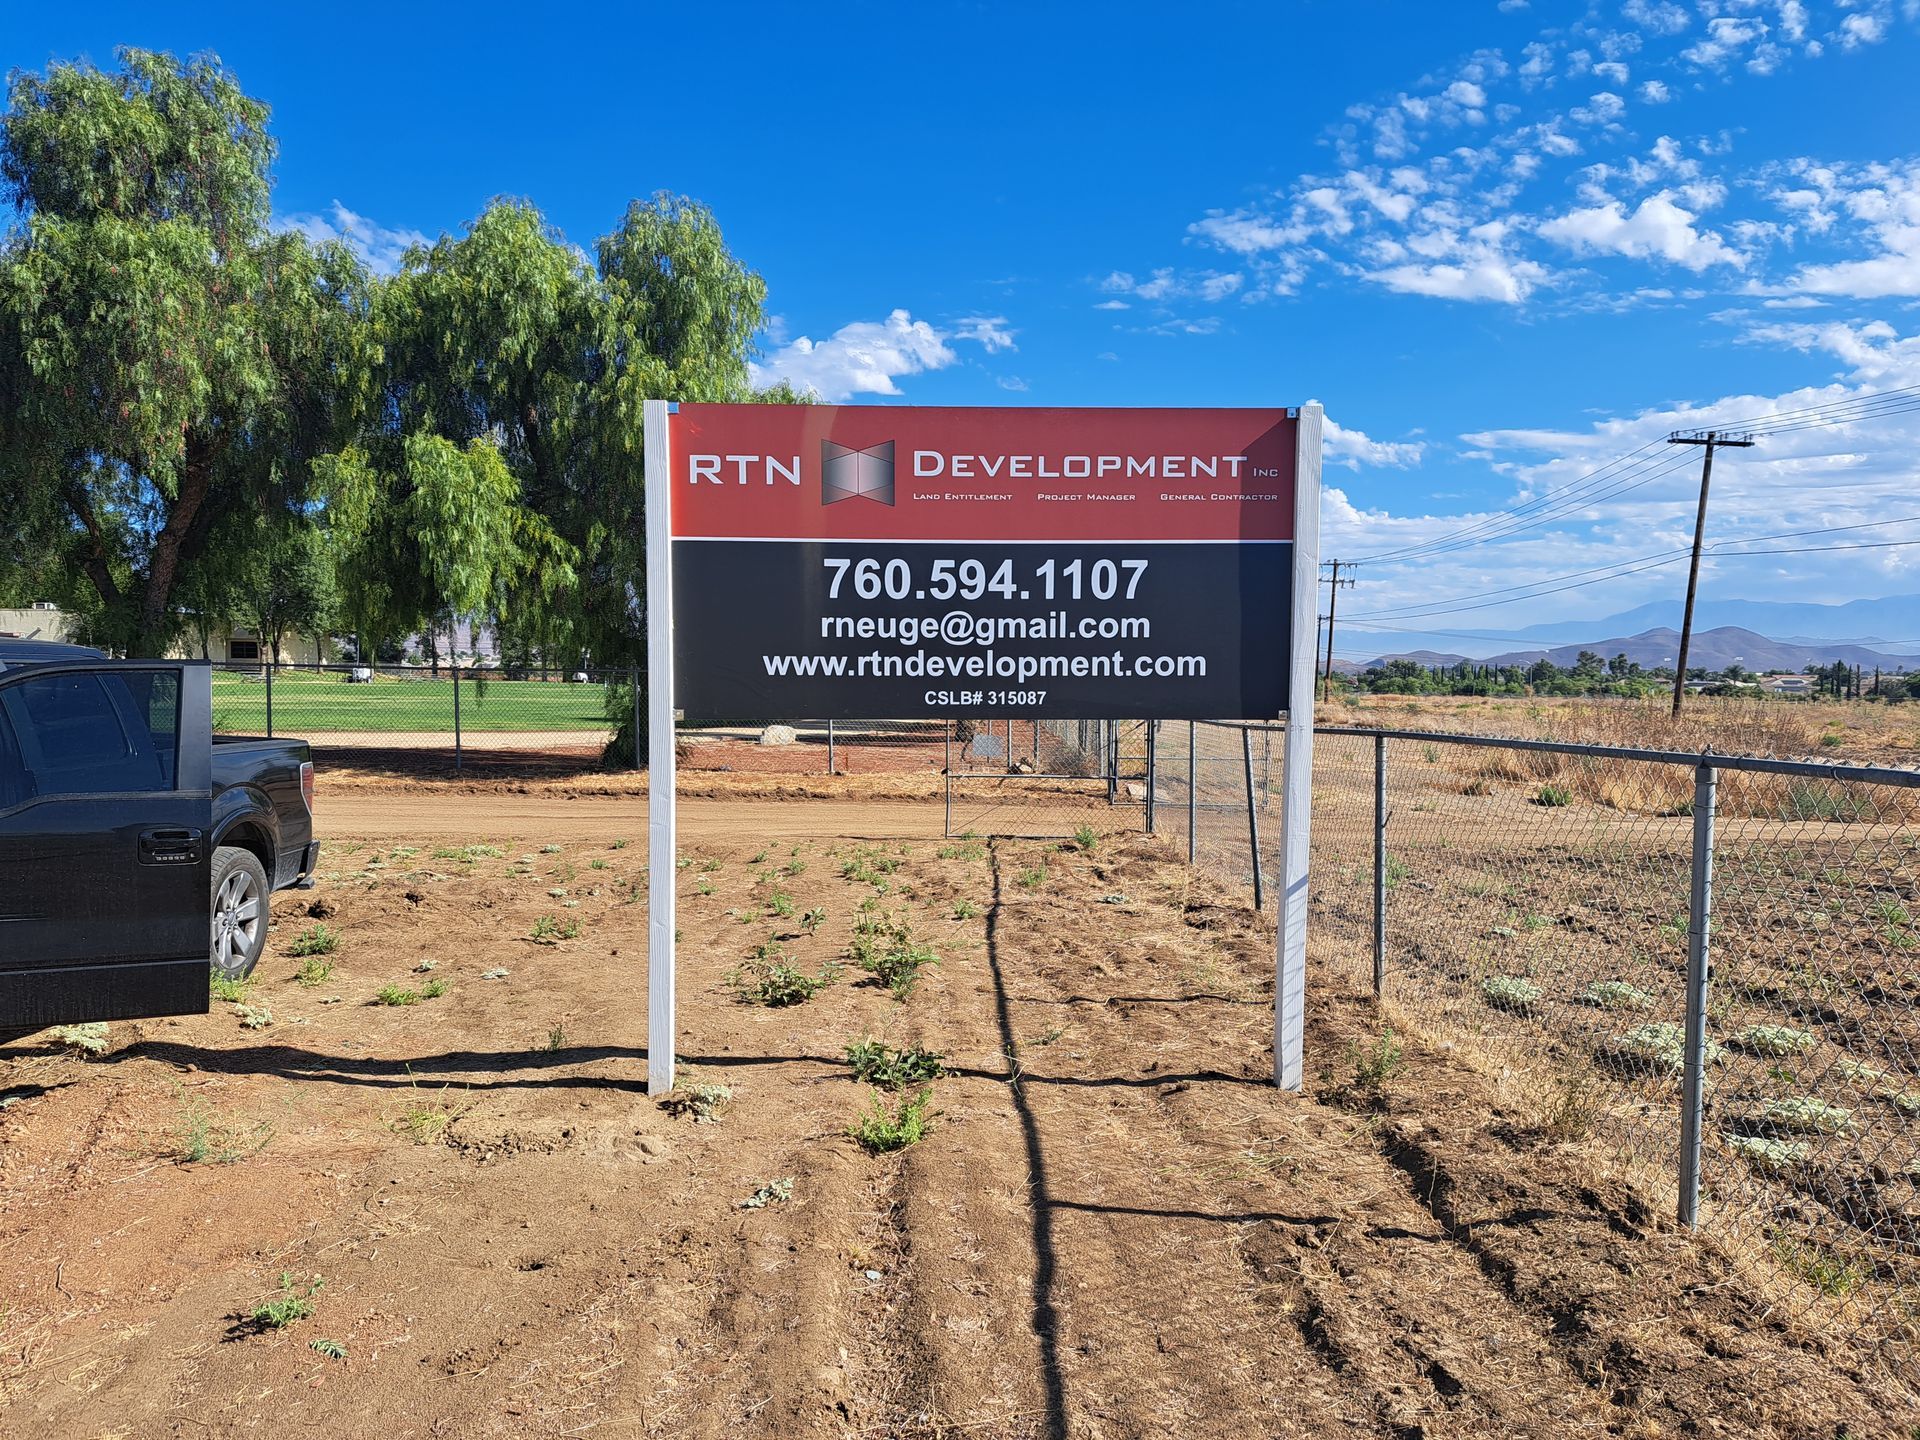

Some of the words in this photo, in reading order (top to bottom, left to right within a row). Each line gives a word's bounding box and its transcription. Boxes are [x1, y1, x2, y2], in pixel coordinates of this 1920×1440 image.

[689, 454, 801, 486] RTN
[913, 450, 1247, 478] DEVELOPMENT
[1253, 467, 1279, 477] INC
[913, 492, 941, 500] LAND
[944, 493, 1013, 501] ENTITLEMENT
[1037, 493, 1083, 501] PROJECT
[1086, 493, 1136, 501] MANAGER
[1160, 493, 1207, 501] GENERAL
[1210, 493, 1279, 501] CONTRACTOR
[823, 558, 1149, 601] 760.594.1107
[821, 610, 1150, 646] rneuge@gmail.com
[762, 649, 1207, 684] www.rtndevelopment.com
[924, 690, 984, 706] CSLB#
[987, 690, 1047, 705] 315087
